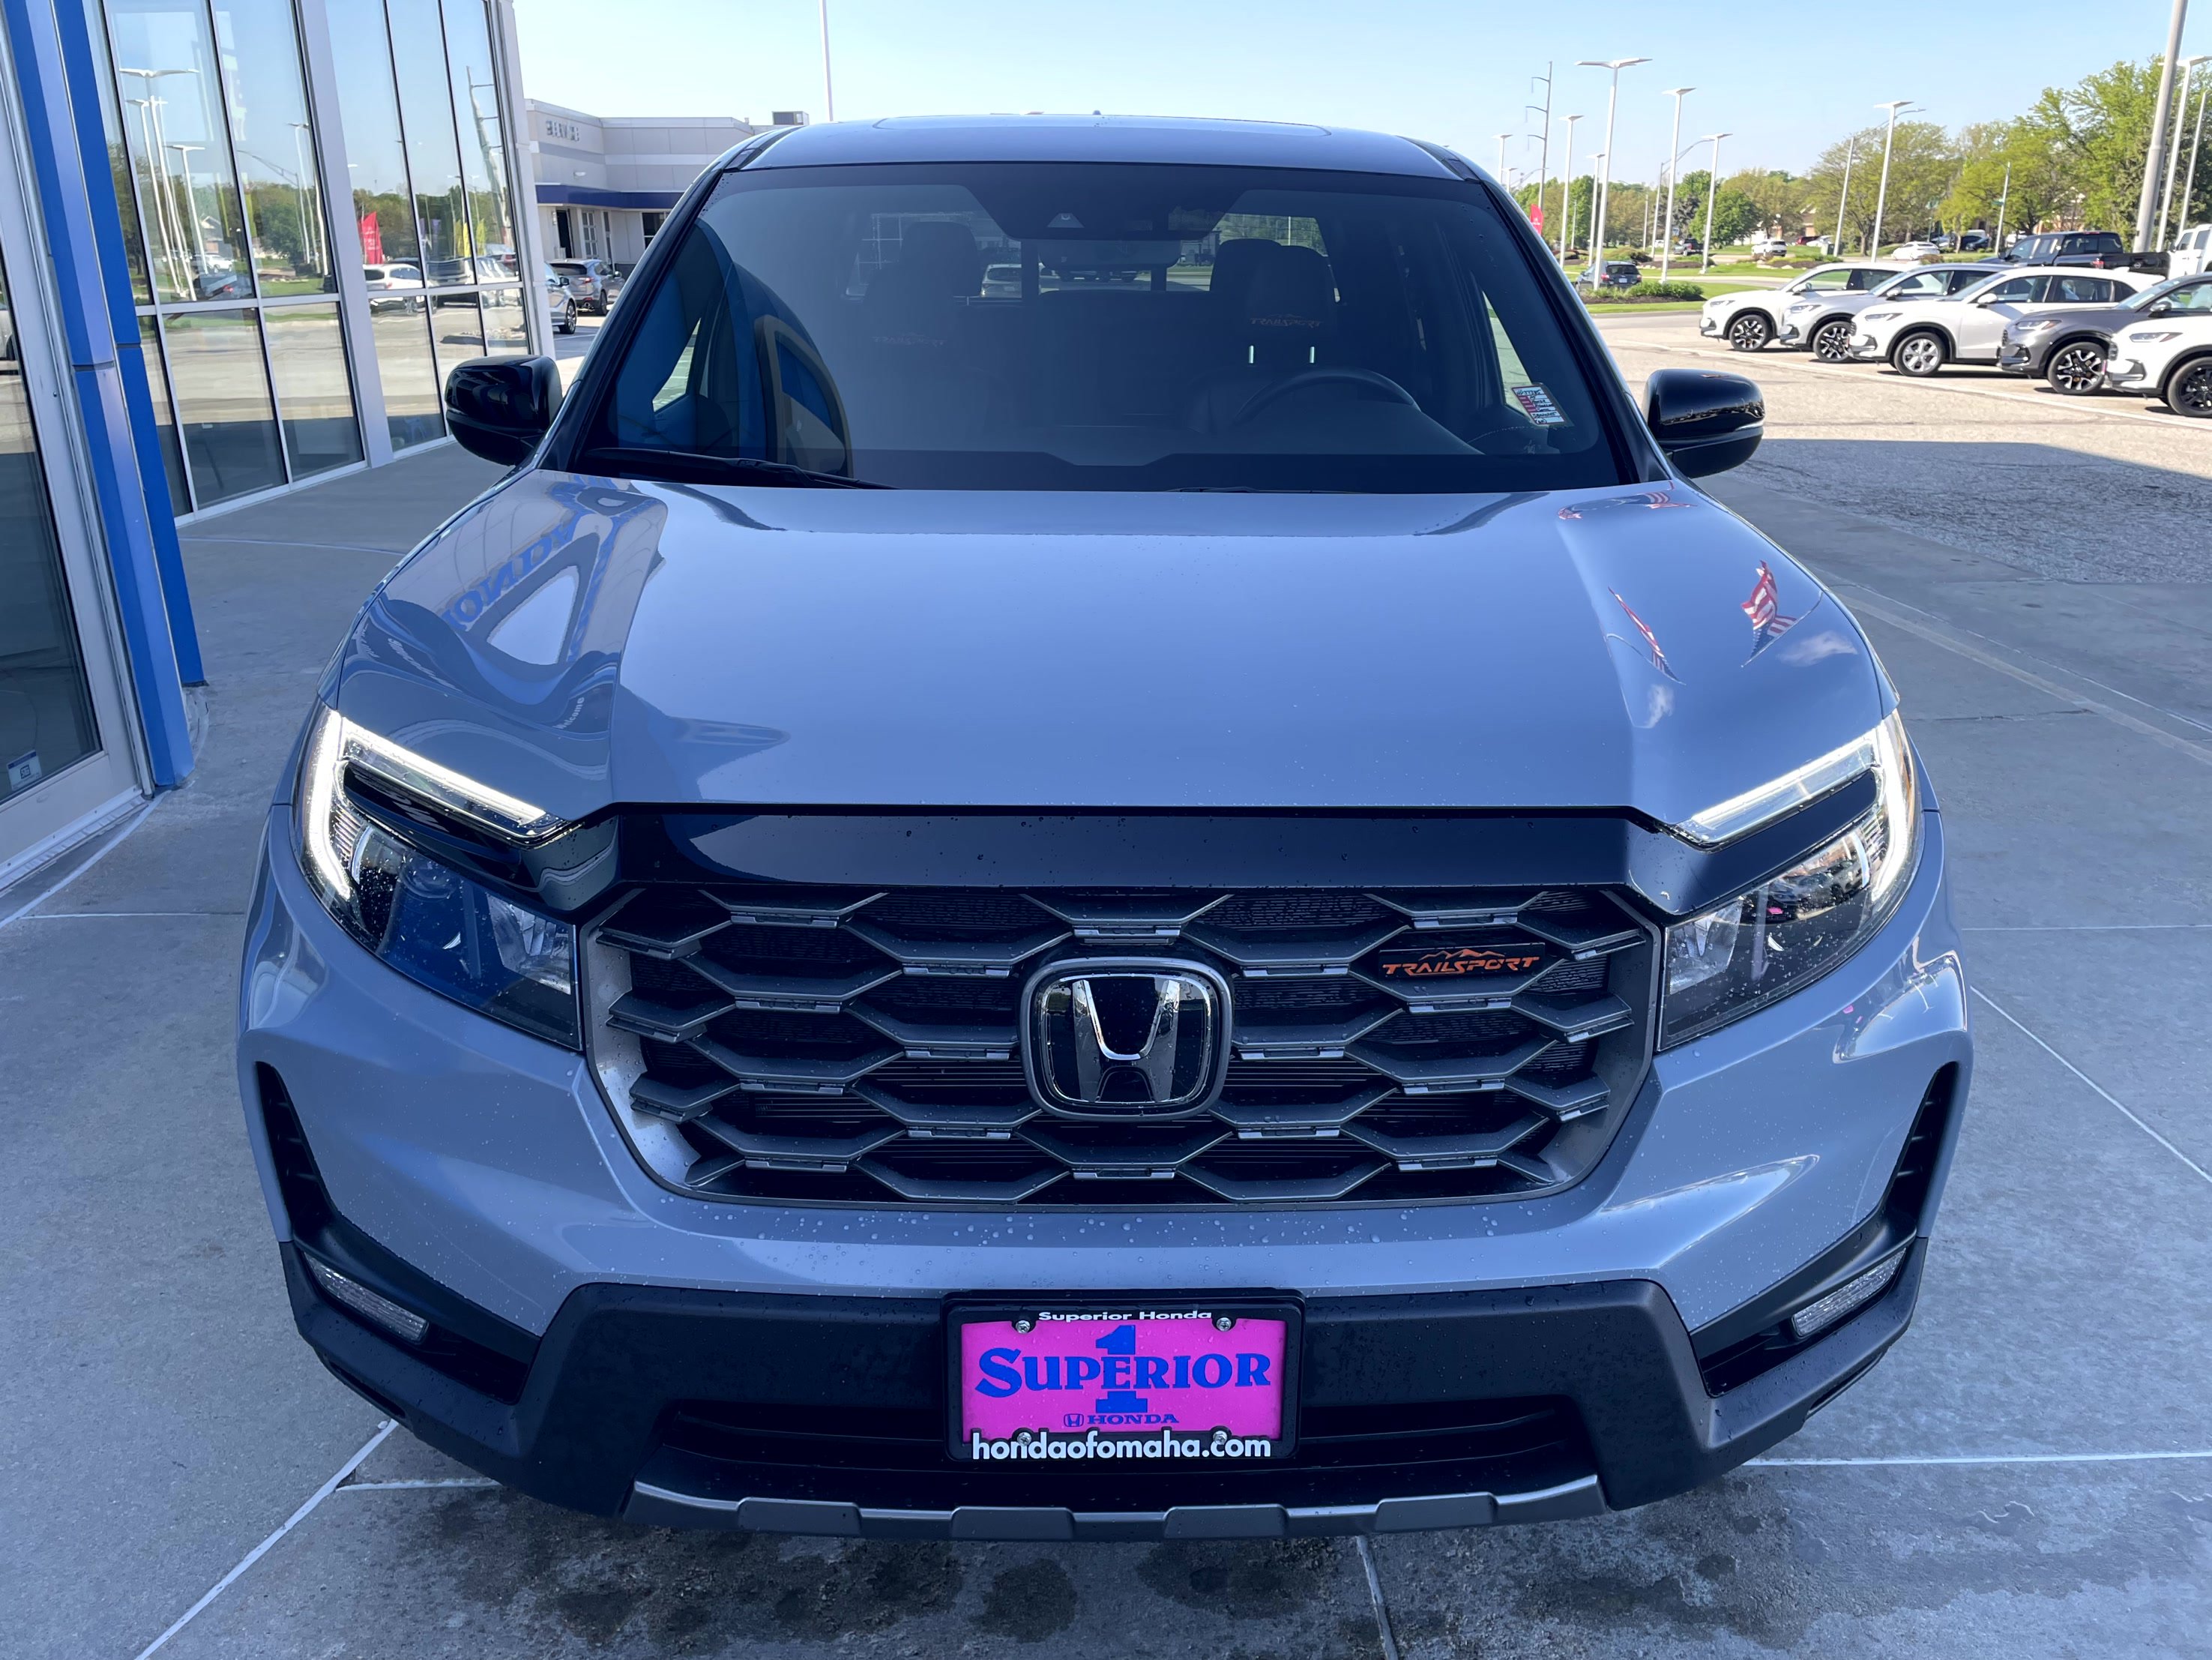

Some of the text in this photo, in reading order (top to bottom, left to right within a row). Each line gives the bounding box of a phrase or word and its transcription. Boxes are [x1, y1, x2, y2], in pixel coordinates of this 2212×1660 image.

[1382, 956, 1540, 977] TRAILSPORT
[1038, 1310, 1212, 1323] Superior Honda
[974, 1347, 1271, 1398] SUPERIOR
[1087, 1413, 1180, 1425] HONDA
[972, 1431, 1271, 1461] hondaofomaha.com
